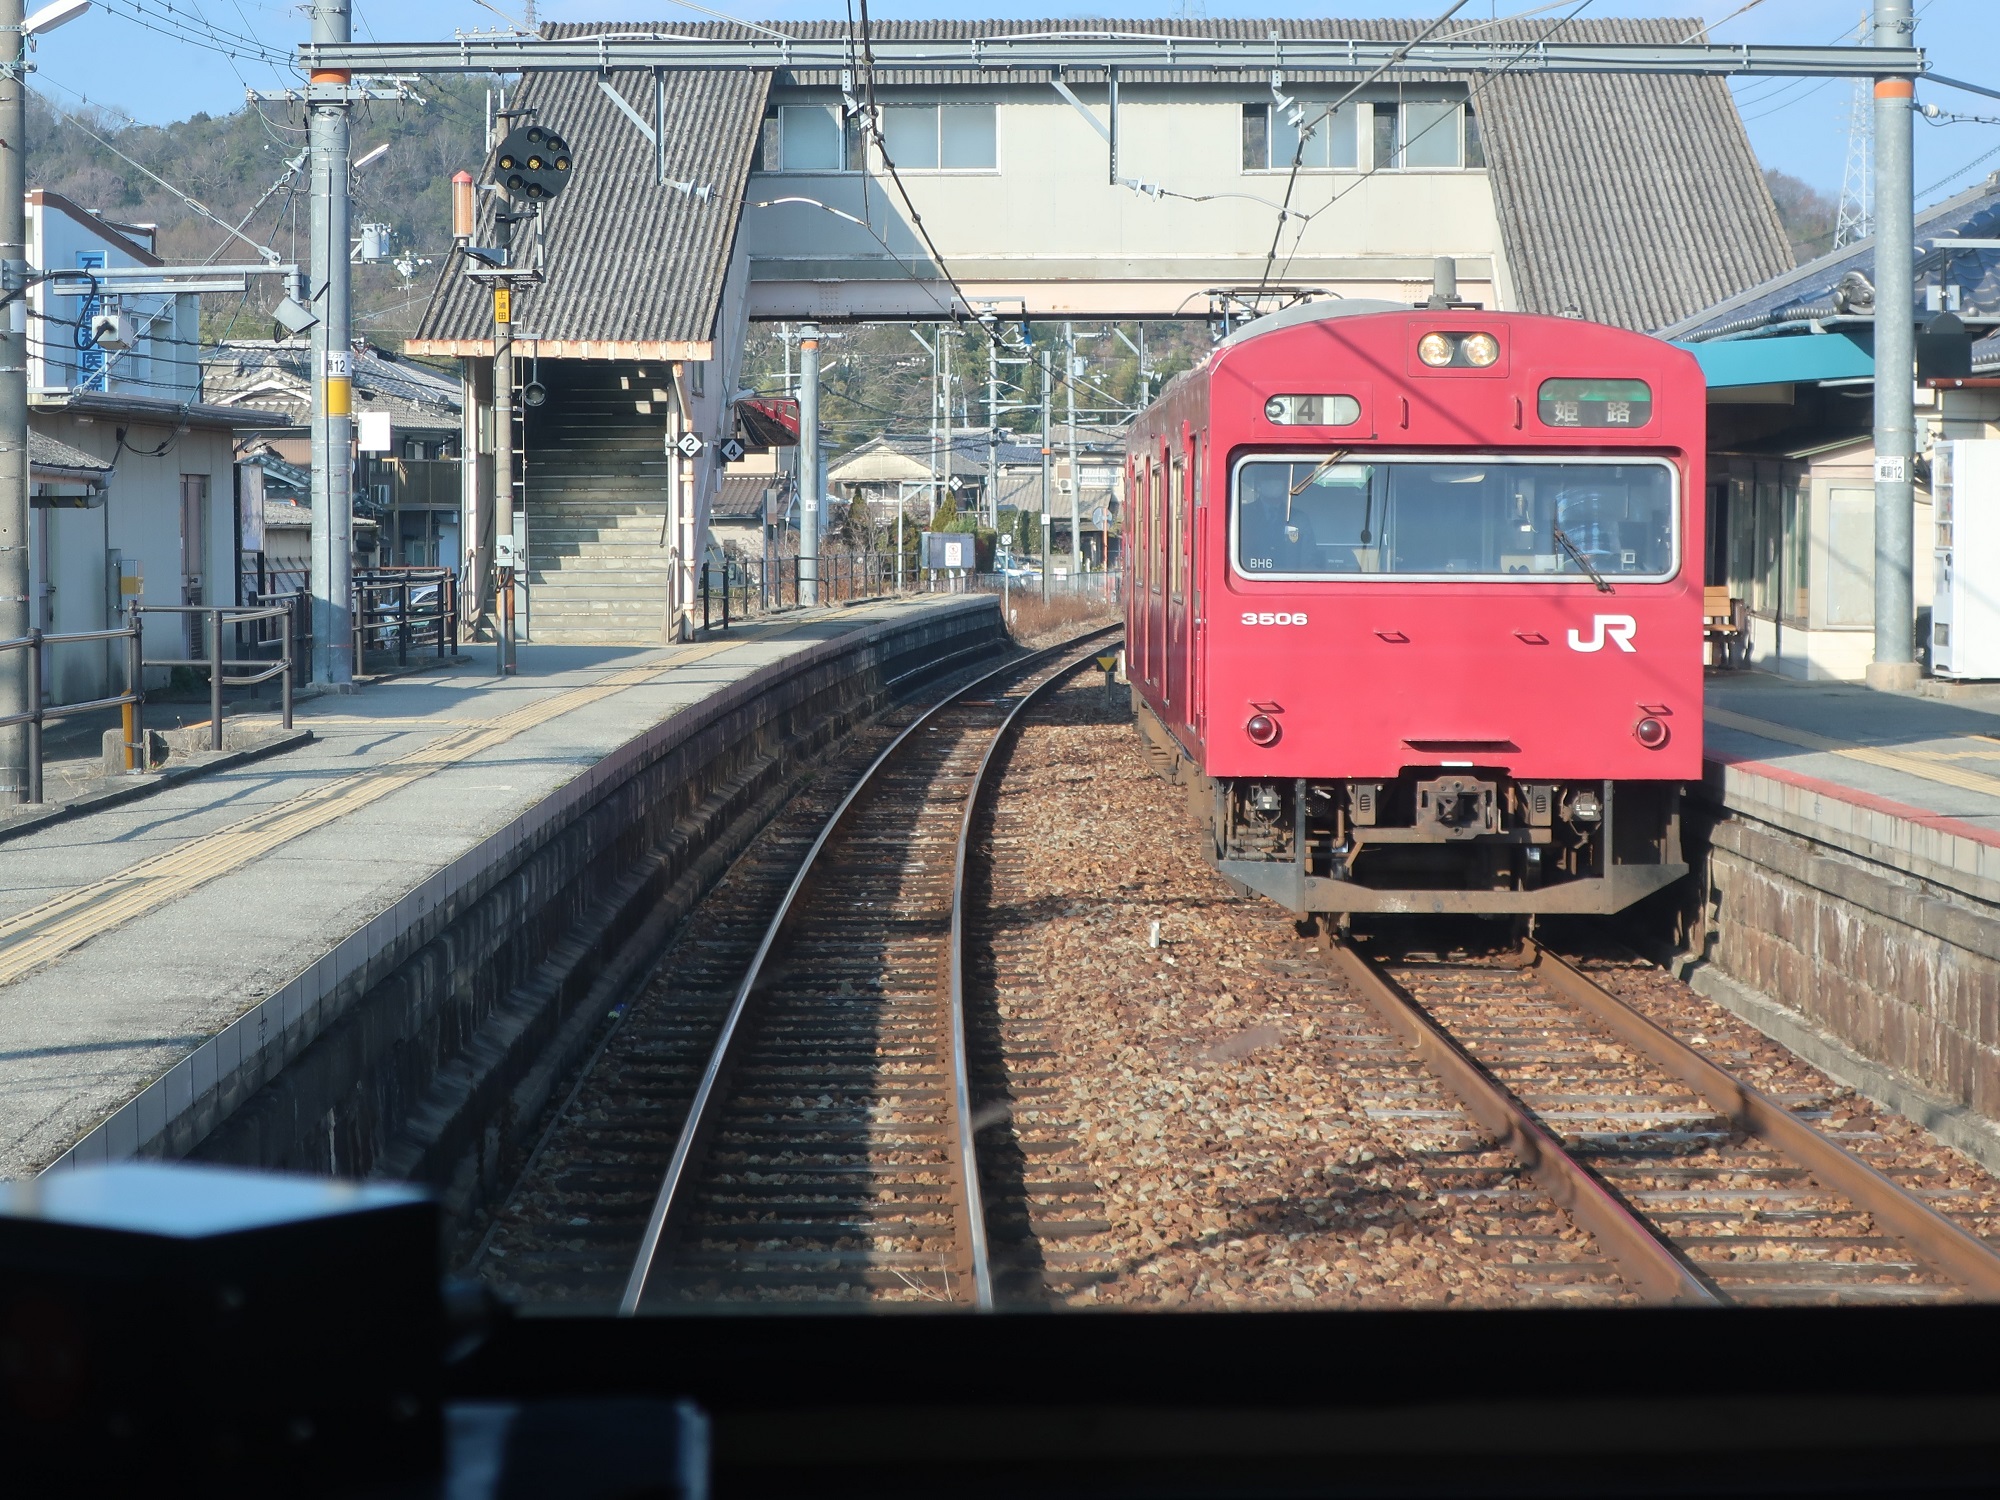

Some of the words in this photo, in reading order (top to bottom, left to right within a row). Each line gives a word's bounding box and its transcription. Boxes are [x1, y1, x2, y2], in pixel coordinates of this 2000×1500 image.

[1297, 397, 1316, 422] 4
[1555, 401, 1631, 423] 姫路
[685, 437, 695, 452] 2
[728, 443, 737, 457] 4
[1250, 558, 1273, 569] BH6
[1241, 612, 1308, 626] 3506
[1567, 614, 1637, 653] JR
